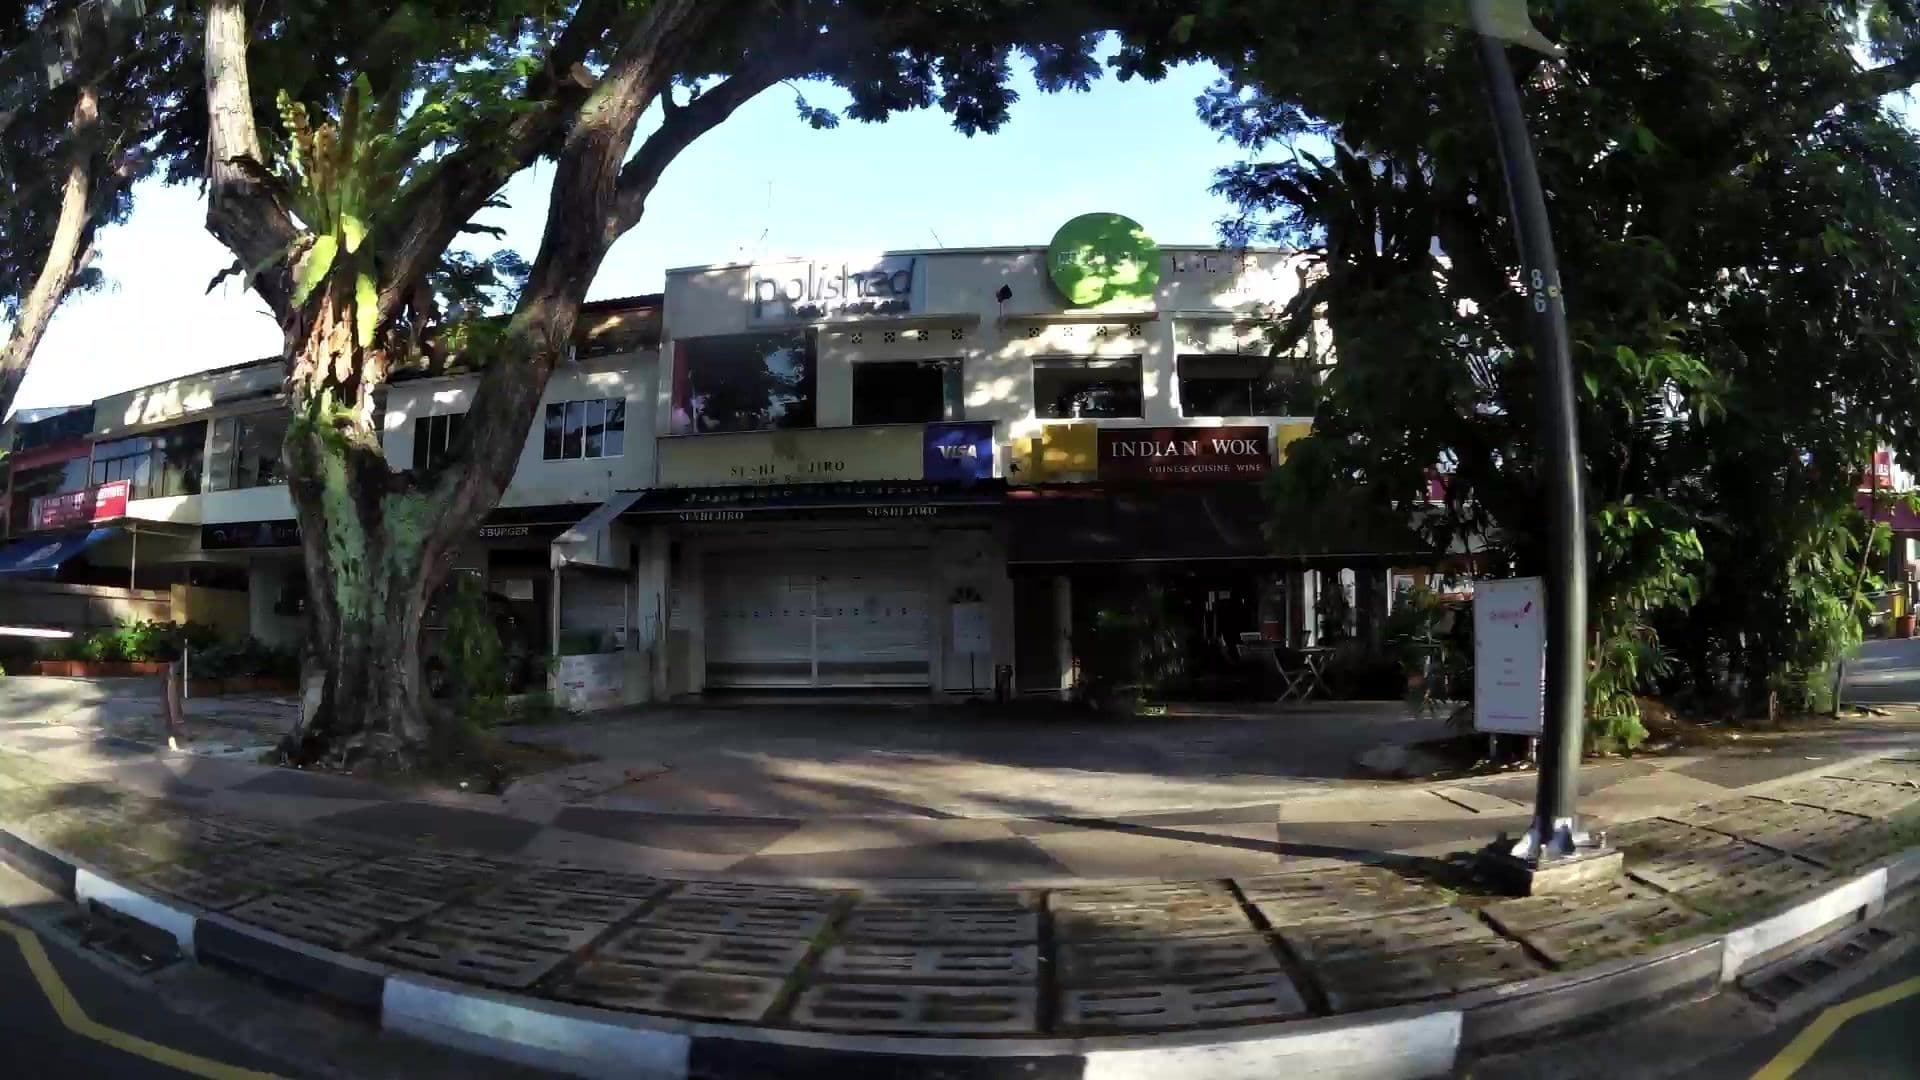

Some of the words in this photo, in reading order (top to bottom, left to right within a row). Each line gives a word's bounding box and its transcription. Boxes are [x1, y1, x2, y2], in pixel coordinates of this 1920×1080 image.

[754, 258, 916, 318] polished
[936, 444, 978, 459] VISA
[1112, 440, 1199, 457] INDIAN
[1212, 438, 1259, 456] WOK
[807, 461, 846, 474] JIRO
[1236, 463, 1261, 472] WINE
[716, 510, 744, 521] JIRO
[487, 526, 529, 537] BURGER
